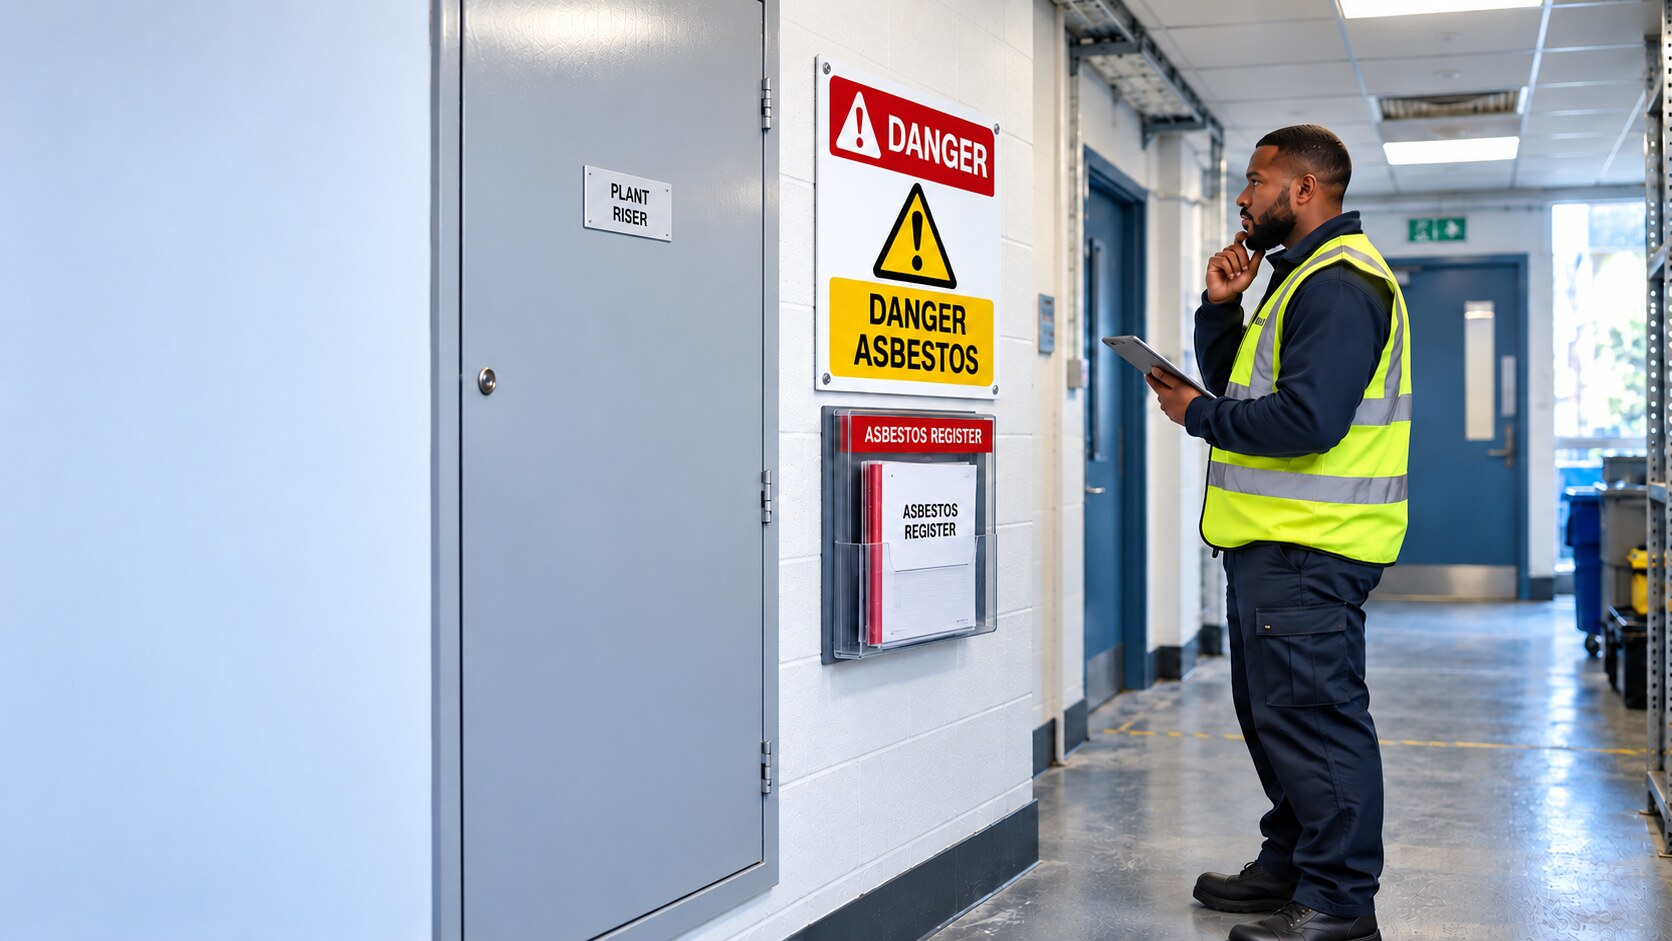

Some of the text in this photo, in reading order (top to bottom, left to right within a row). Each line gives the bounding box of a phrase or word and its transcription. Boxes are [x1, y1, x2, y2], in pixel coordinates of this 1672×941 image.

[888, 115, 988, 178] DANGER
[610, 183, 650, 206] PLANT
[613, 206, 648, 227] RISER
[869, 293, 966, 335] DANGER
[853, 334, 979, 375] ASBESTOS
[865, 426, 982, 444] ASBESTOS REGISTER
[903, 503, 958, 519] ASBESTOS
[905, 523, 956, 540] REGISTER
